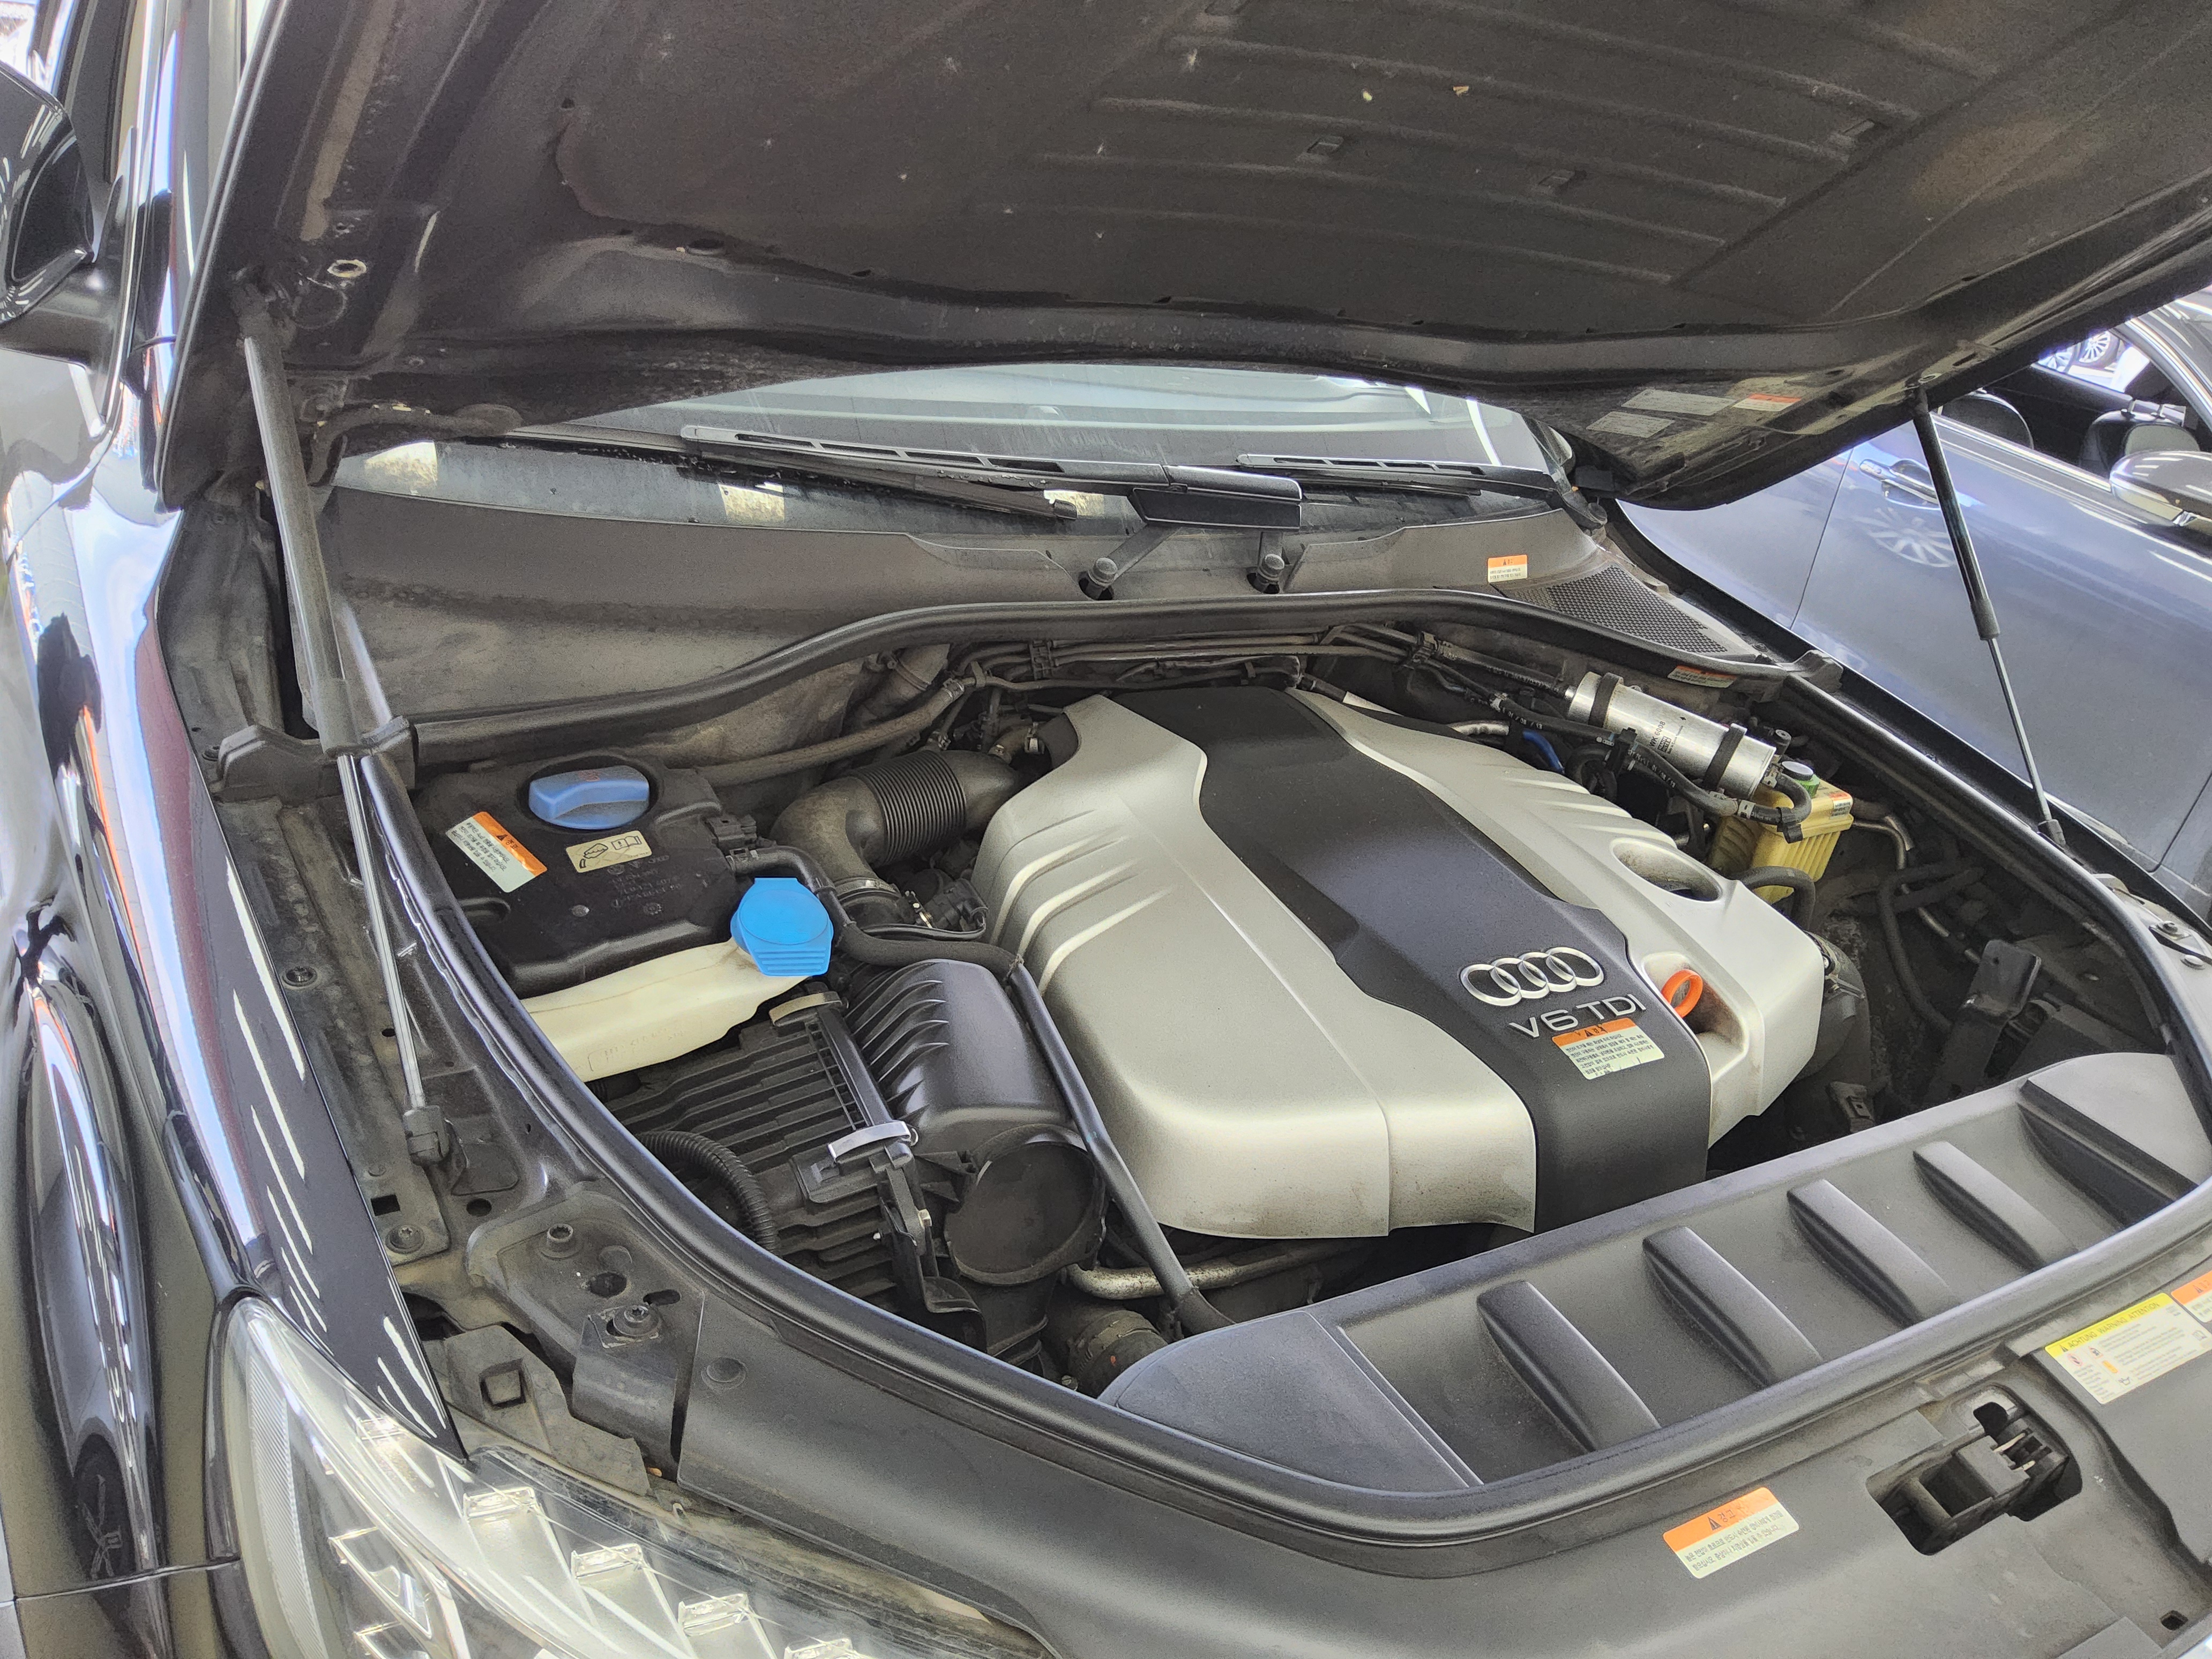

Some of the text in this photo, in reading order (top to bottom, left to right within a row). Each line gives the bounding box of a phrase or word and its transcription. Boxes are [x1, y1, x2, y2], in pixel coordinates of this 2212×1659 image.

[1649, 721, 1665, 747] WK 6008
[1509, 993, 1646, 1038] V6 TDI
[2068, 1332, 2097, 1347] ACHTUNG
[2097, 1317, 2127, 1333] WARNING
[2128, 1303, 2159, 1318] ATTENTION
[1717, 1509, 1736, 1522] 경고
[1685, 1553, 1696, 1561] 높은
[1694, 1548, 1707, 1557] 전압이
[1724, 1531, 1739, 1543] 반드시
[1714, 1547, 1732, 1560] 중상이나
